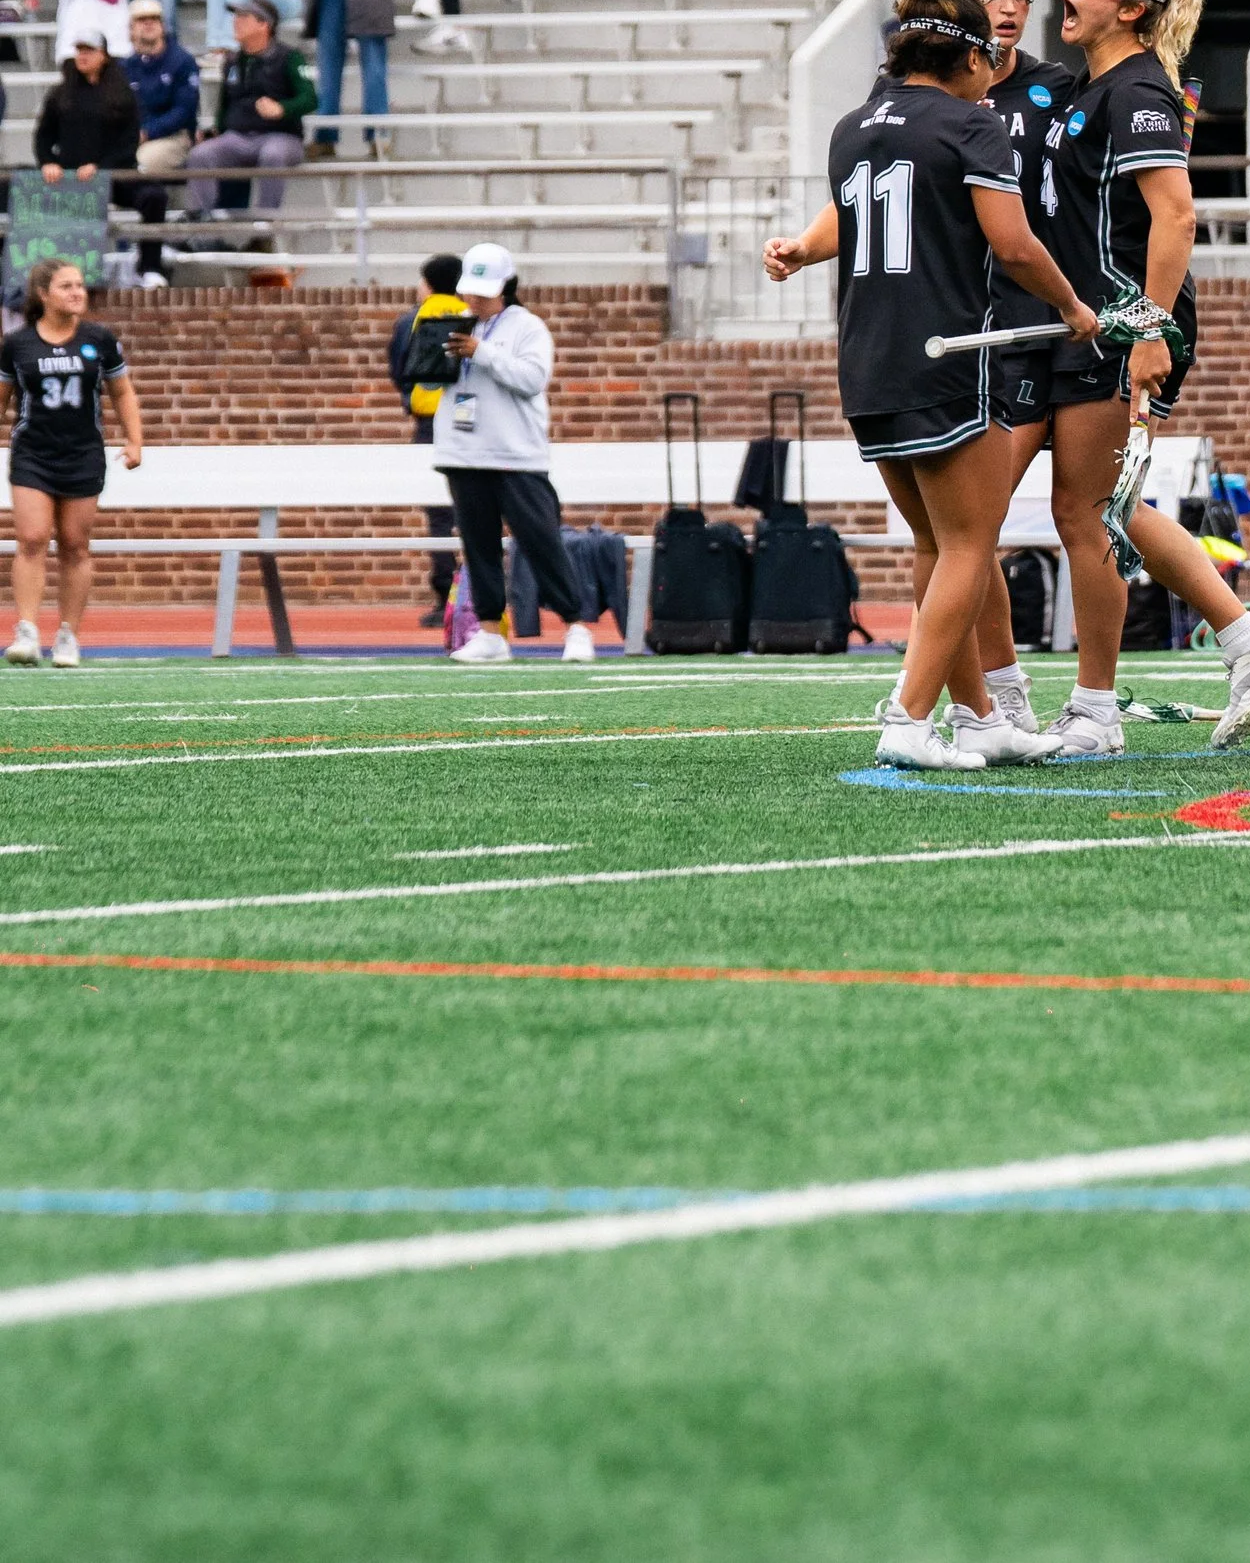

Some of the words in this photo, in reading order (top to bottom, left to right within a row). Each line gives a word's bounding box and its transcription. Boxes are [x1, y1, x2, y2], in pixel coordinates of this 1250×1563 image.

[910, 21, 933, 30] GAIT
[936, 25, 963, 37] GAIT
[965, 34, 984, 46] GAIT
[885, 115, 906, 125] DOG
[1131, 119, 1170, 128] PATRIOT
[1131, 124, 1171, 133] LEAGUE
[841, 160, 914, 276] 11
[38, 355, 84, 374] LOYOLA
[41, 375, 82, 409] 34
[1017, 379, 1035, 406] L
